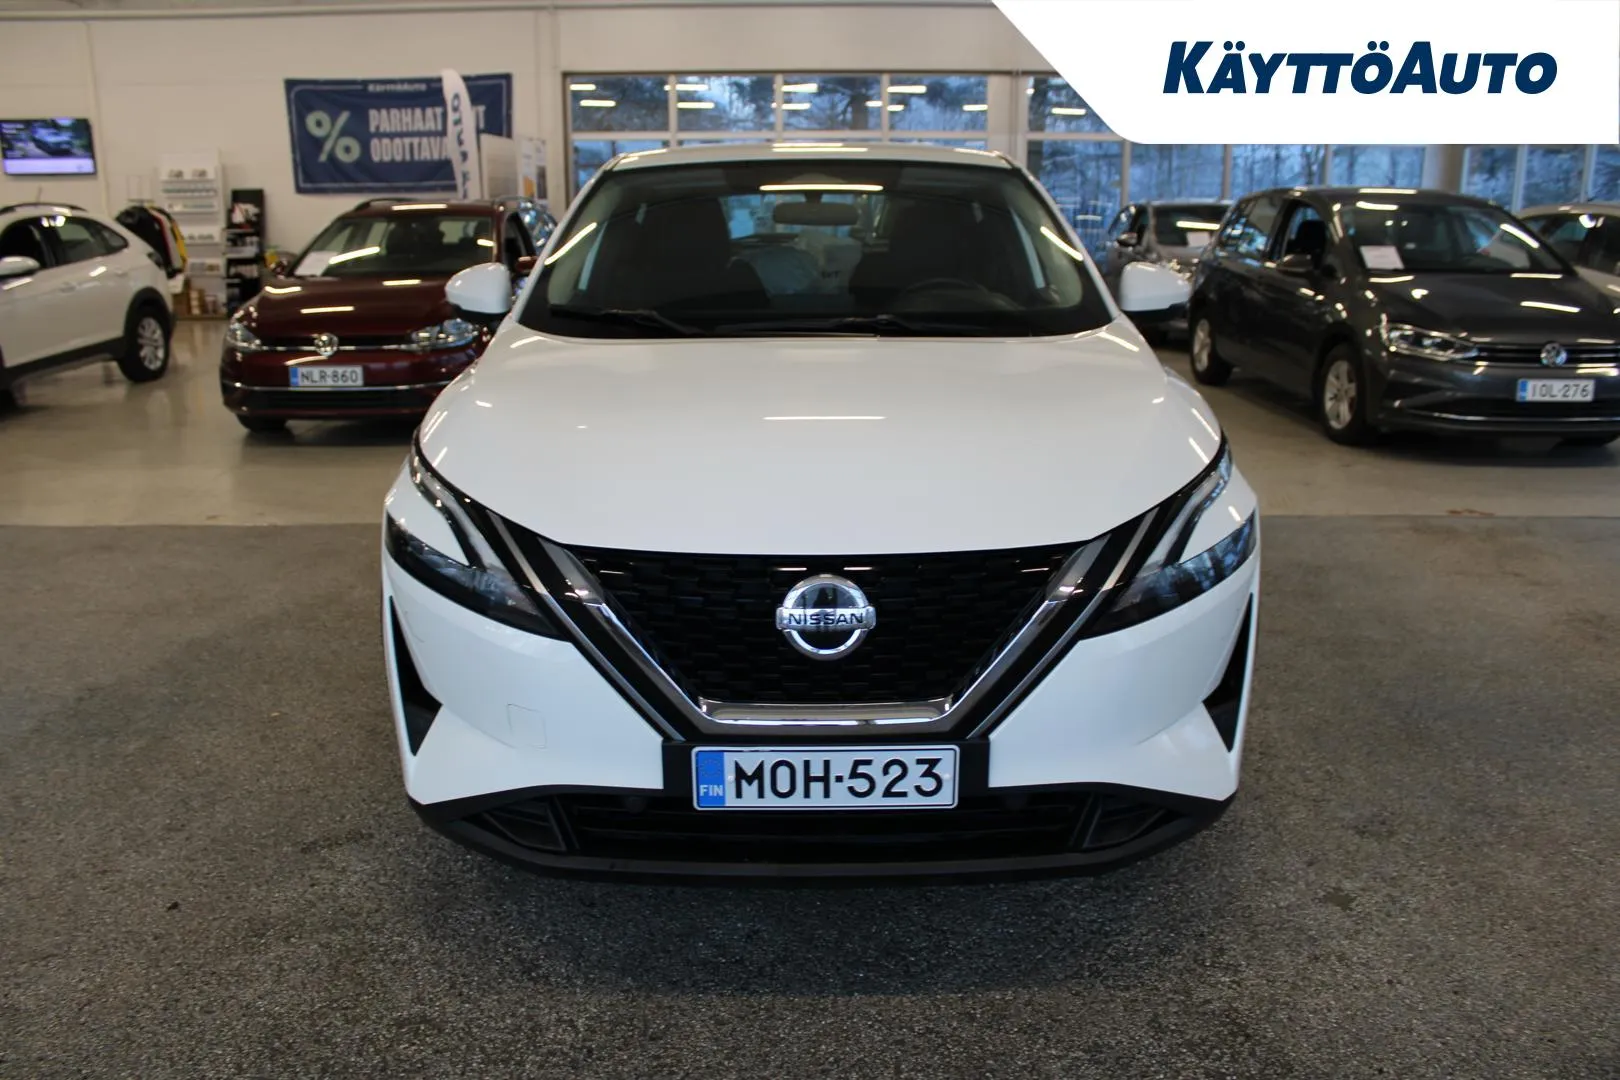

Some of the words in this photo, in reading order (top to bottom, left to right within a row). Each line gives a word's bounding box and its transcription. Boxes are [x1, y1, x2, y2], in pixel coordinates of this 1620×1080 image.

[368, 106, 444, 133] PARHAAT
[370, 136, 452, 163] ODOTTAVA
[301, 369, 358, 384] NLR-860
[788, 612, 865, 626] NISSAN
[734, 757, 944, 799] MOH-523
[699, 784, 724, 797] FIN
